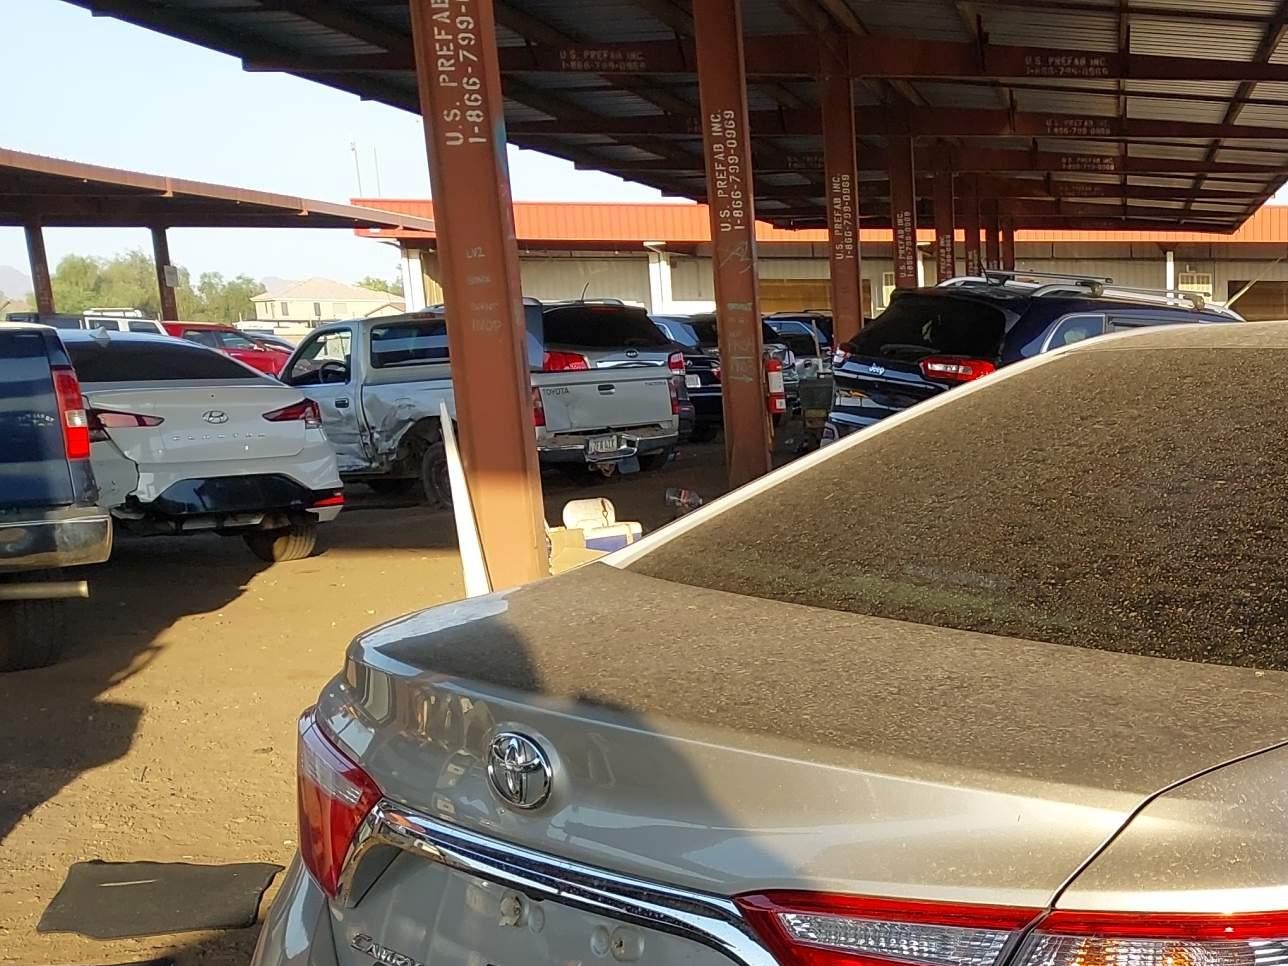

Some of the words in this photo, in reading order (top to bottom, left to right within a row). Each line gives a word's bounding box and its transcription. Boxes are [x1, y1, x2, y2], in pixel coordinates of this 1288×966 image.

[456, 0, 487, 143] 1-866-799-
[443, 101, 464, 146] U.S.
[710, 109, 723, 136] INC.
[713, 143, 729, 198] PREFAB
[723, 110, 745, 231] 1-866-799-0969
[719, 205, 732, 232] U.S.
[833, 197, 843, 236] PREFAB
[835, 240, 845, 260] U.S.
[868, 362, 885, 376] Jeep
[542, 386, 569, 397] TOYOTA
